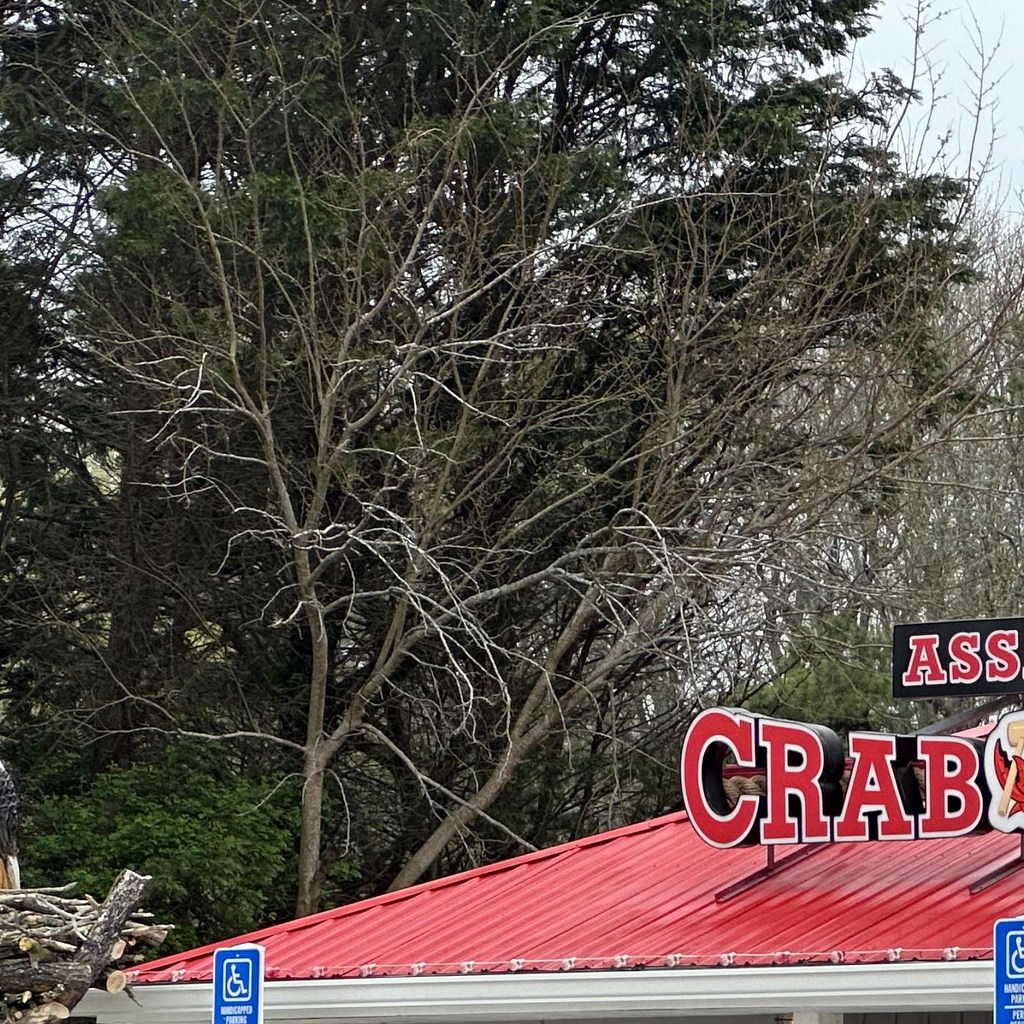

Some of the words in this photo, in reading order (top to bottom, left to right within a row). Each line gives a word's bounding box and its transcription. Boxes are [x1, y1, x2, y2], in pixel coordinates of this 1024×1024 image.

[681, 707, 984, 849] CRAB
[220, 1005, 253, 1015] HANDICAPPED
[225, 1015, 248, 1024] PARKING
